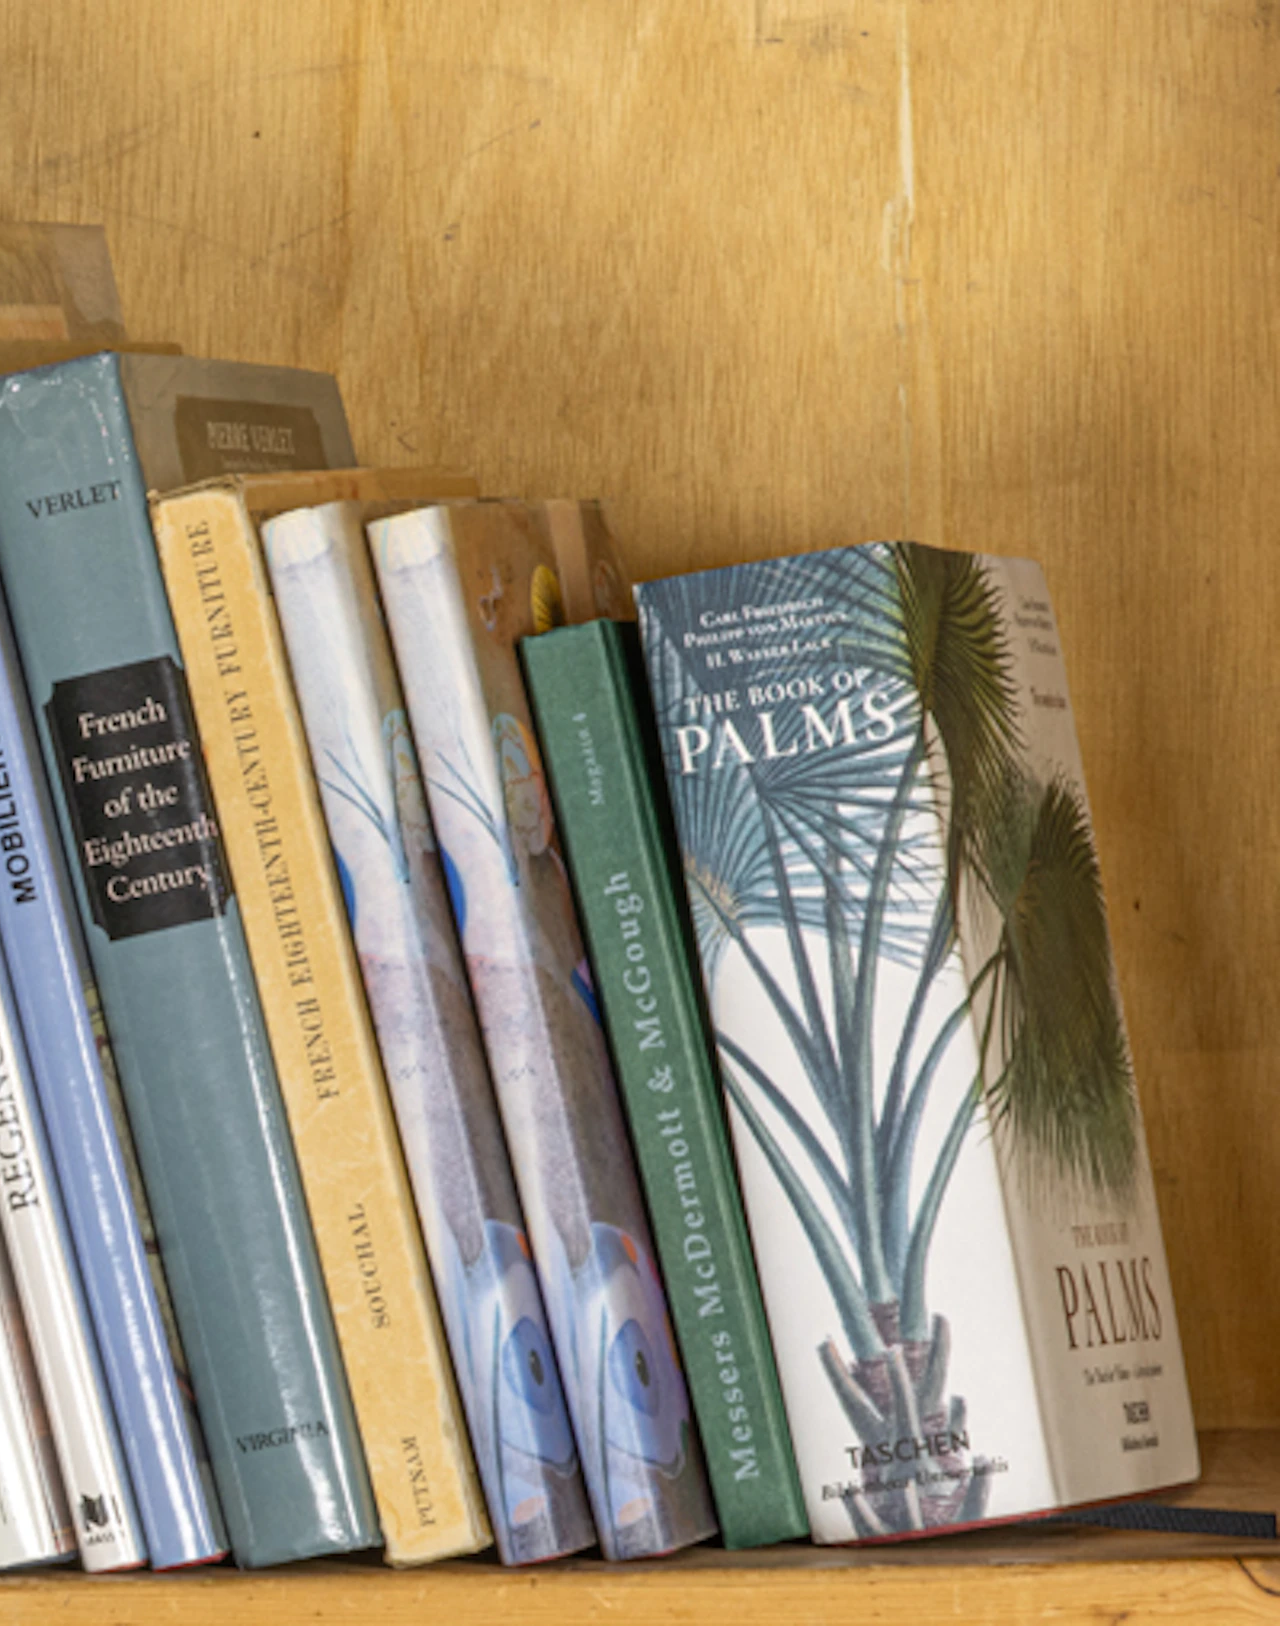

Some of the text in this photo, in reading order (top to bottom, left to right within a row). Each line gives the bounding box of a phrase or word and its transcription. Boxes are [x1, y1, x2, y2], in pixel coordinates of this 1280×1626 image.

[26, 480, 123, 519] VERLET
[699, 610, 739, 628] CARL
[686, 664, 872, 718] THE BOOK OF
[78, 697, 168, 740] French
[675, 689, 899, 776] PALMS
[72, 736, 192, 784] Furniture
[136, 781, 178, 811] the
[186, 520, 340, 1101] FRENCH EIGHTEENTH-CENTURY FURNITURE
[83, 812, 219, 869] Eighteenth
[106, 860, 211, 903] Century
[603, 871, 761, 1481] Messers McDermott McGough
[348, 1202, 390, 1330] SOUCHAL
[1055, 1256, 1164, 1351] PALMS
[844, 1429, 971, 1470] TASCHEN
[402, 1435, 436, 1527] PUTNAM
